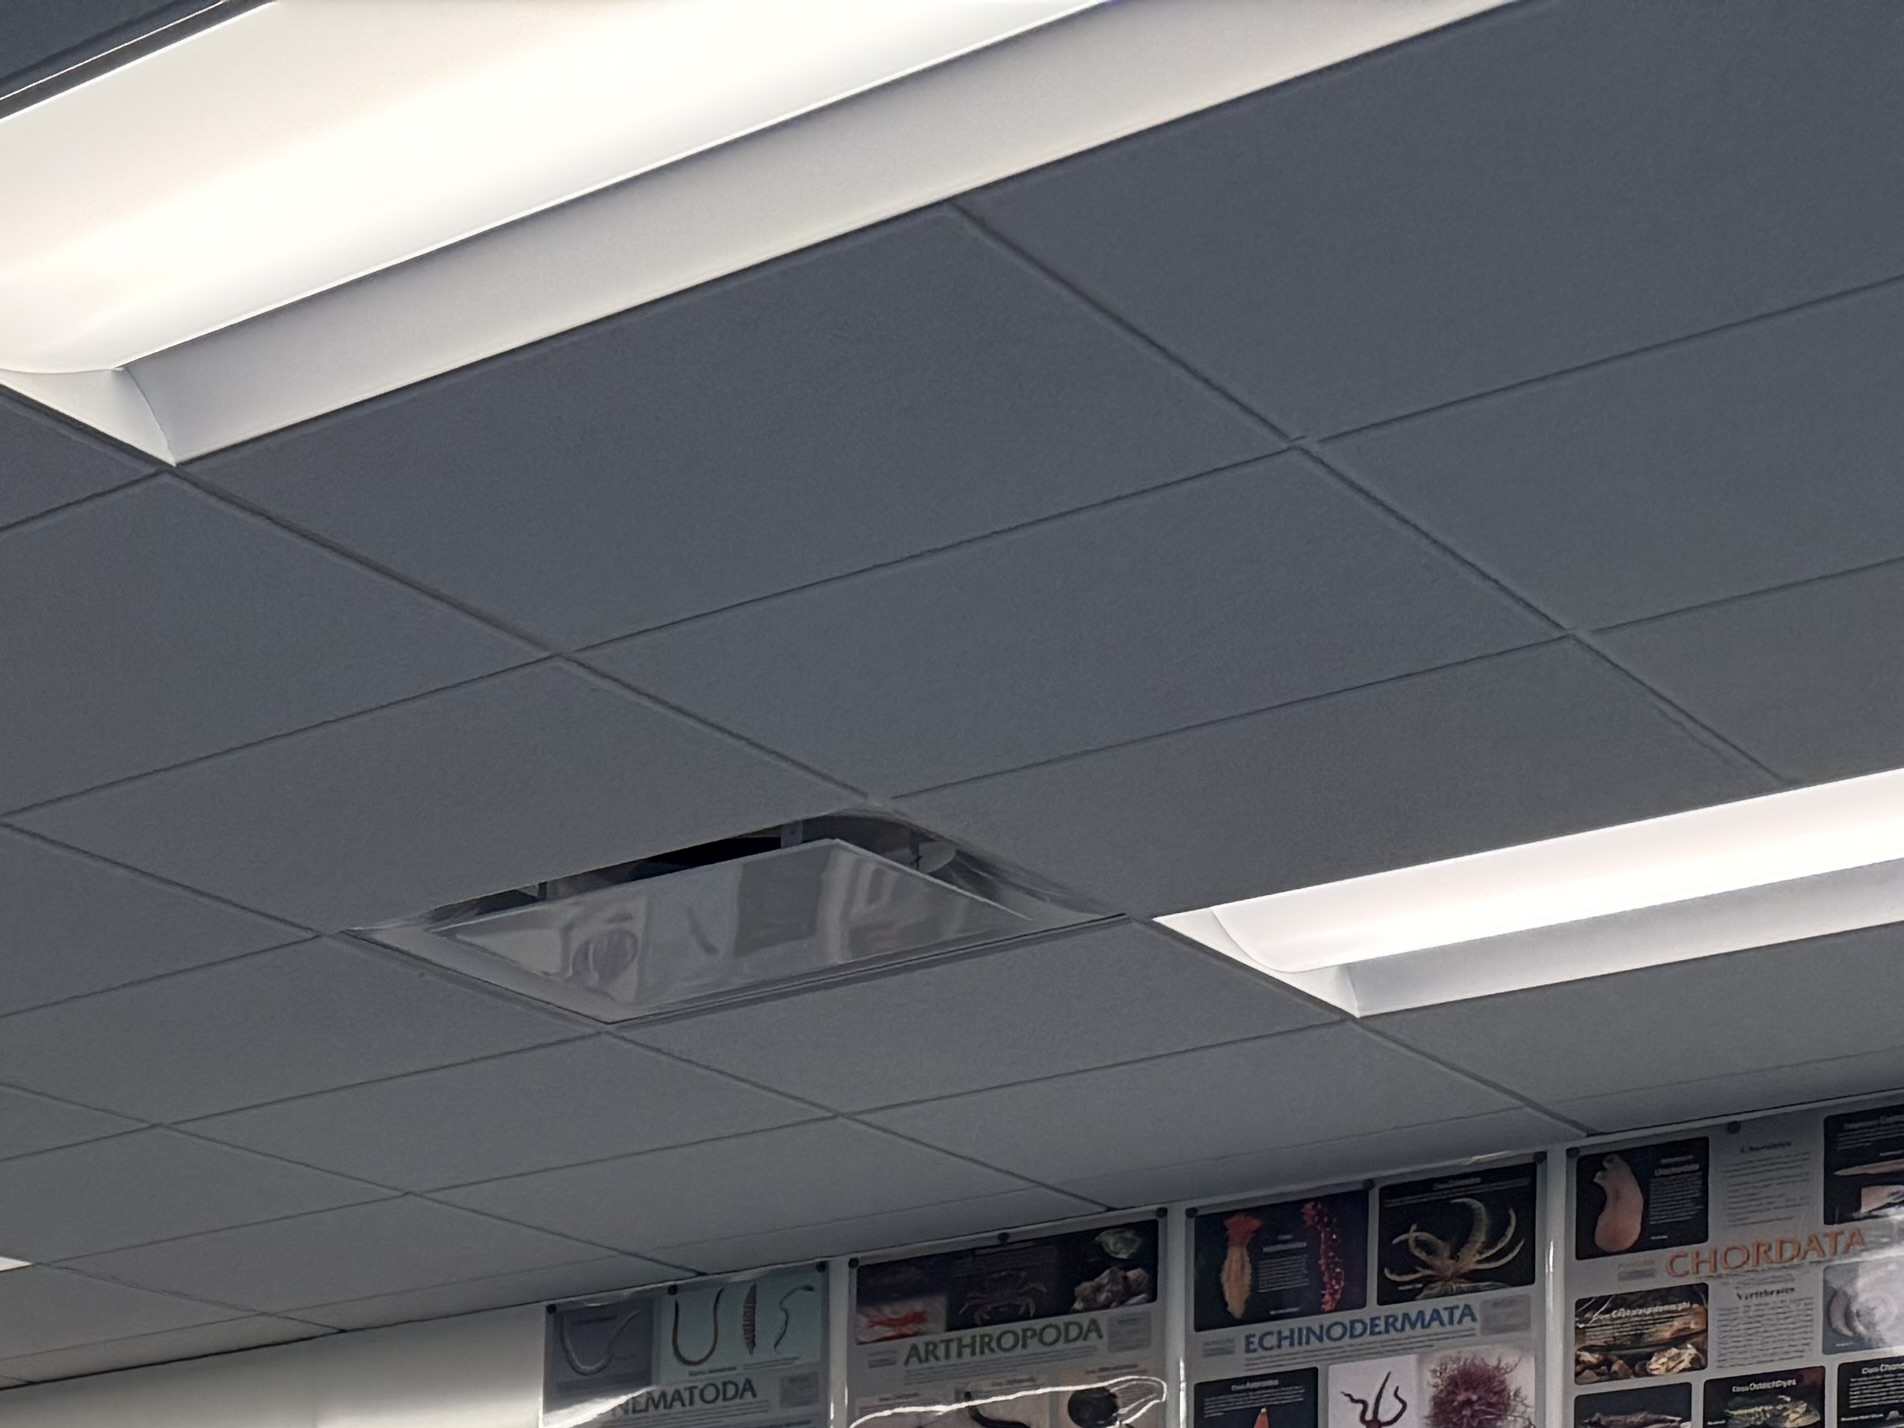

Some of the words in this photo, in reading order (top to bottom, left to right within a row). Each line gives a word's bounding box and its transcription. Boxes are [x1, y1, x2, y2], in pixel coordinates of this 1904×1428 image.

[1665, 1228, 1867, 1278] CHORDATA
[903, 1318, 1104, 1366] ARTHROPODA
[1244, 1303, 1477, 1354] ECHINODERMATA
[610, 1378, 757, 1417] NEMATODA
